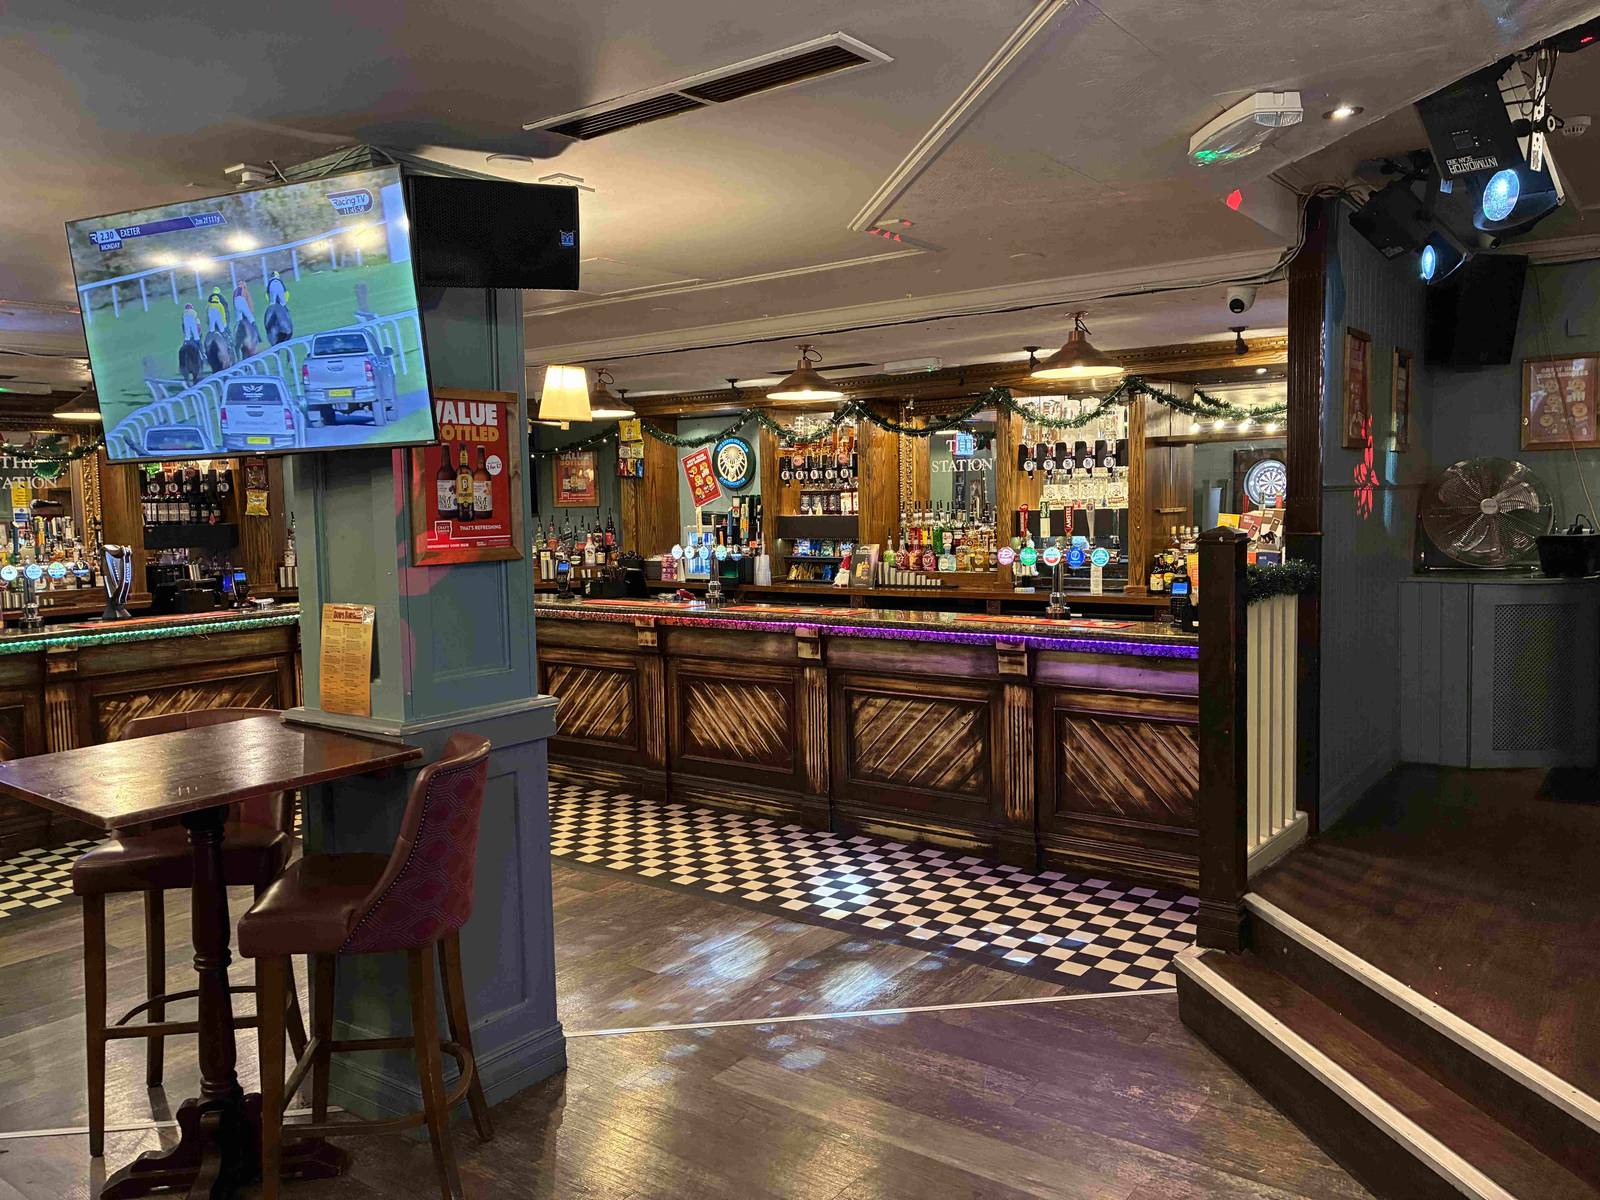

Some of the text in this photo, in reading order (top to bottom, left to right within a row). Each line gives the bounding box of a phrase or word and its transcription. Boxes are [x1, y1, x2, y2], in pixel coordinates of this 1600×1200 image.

[1449, 156, 1499, 174] INTIMIDATOR
[332, 194, 366, 207] Racing TV
[100, 231, 115, 241] 2.30
[120, 226, 141, 238] EXETER
[100, 242, 121, 251] MONDAY
[436, 400, 498, 425] VALUE
[439, 424, 500, 442] OTTLED
[931, 457, 993, 473] STATION
[0, 476, 58, 490] ATION
